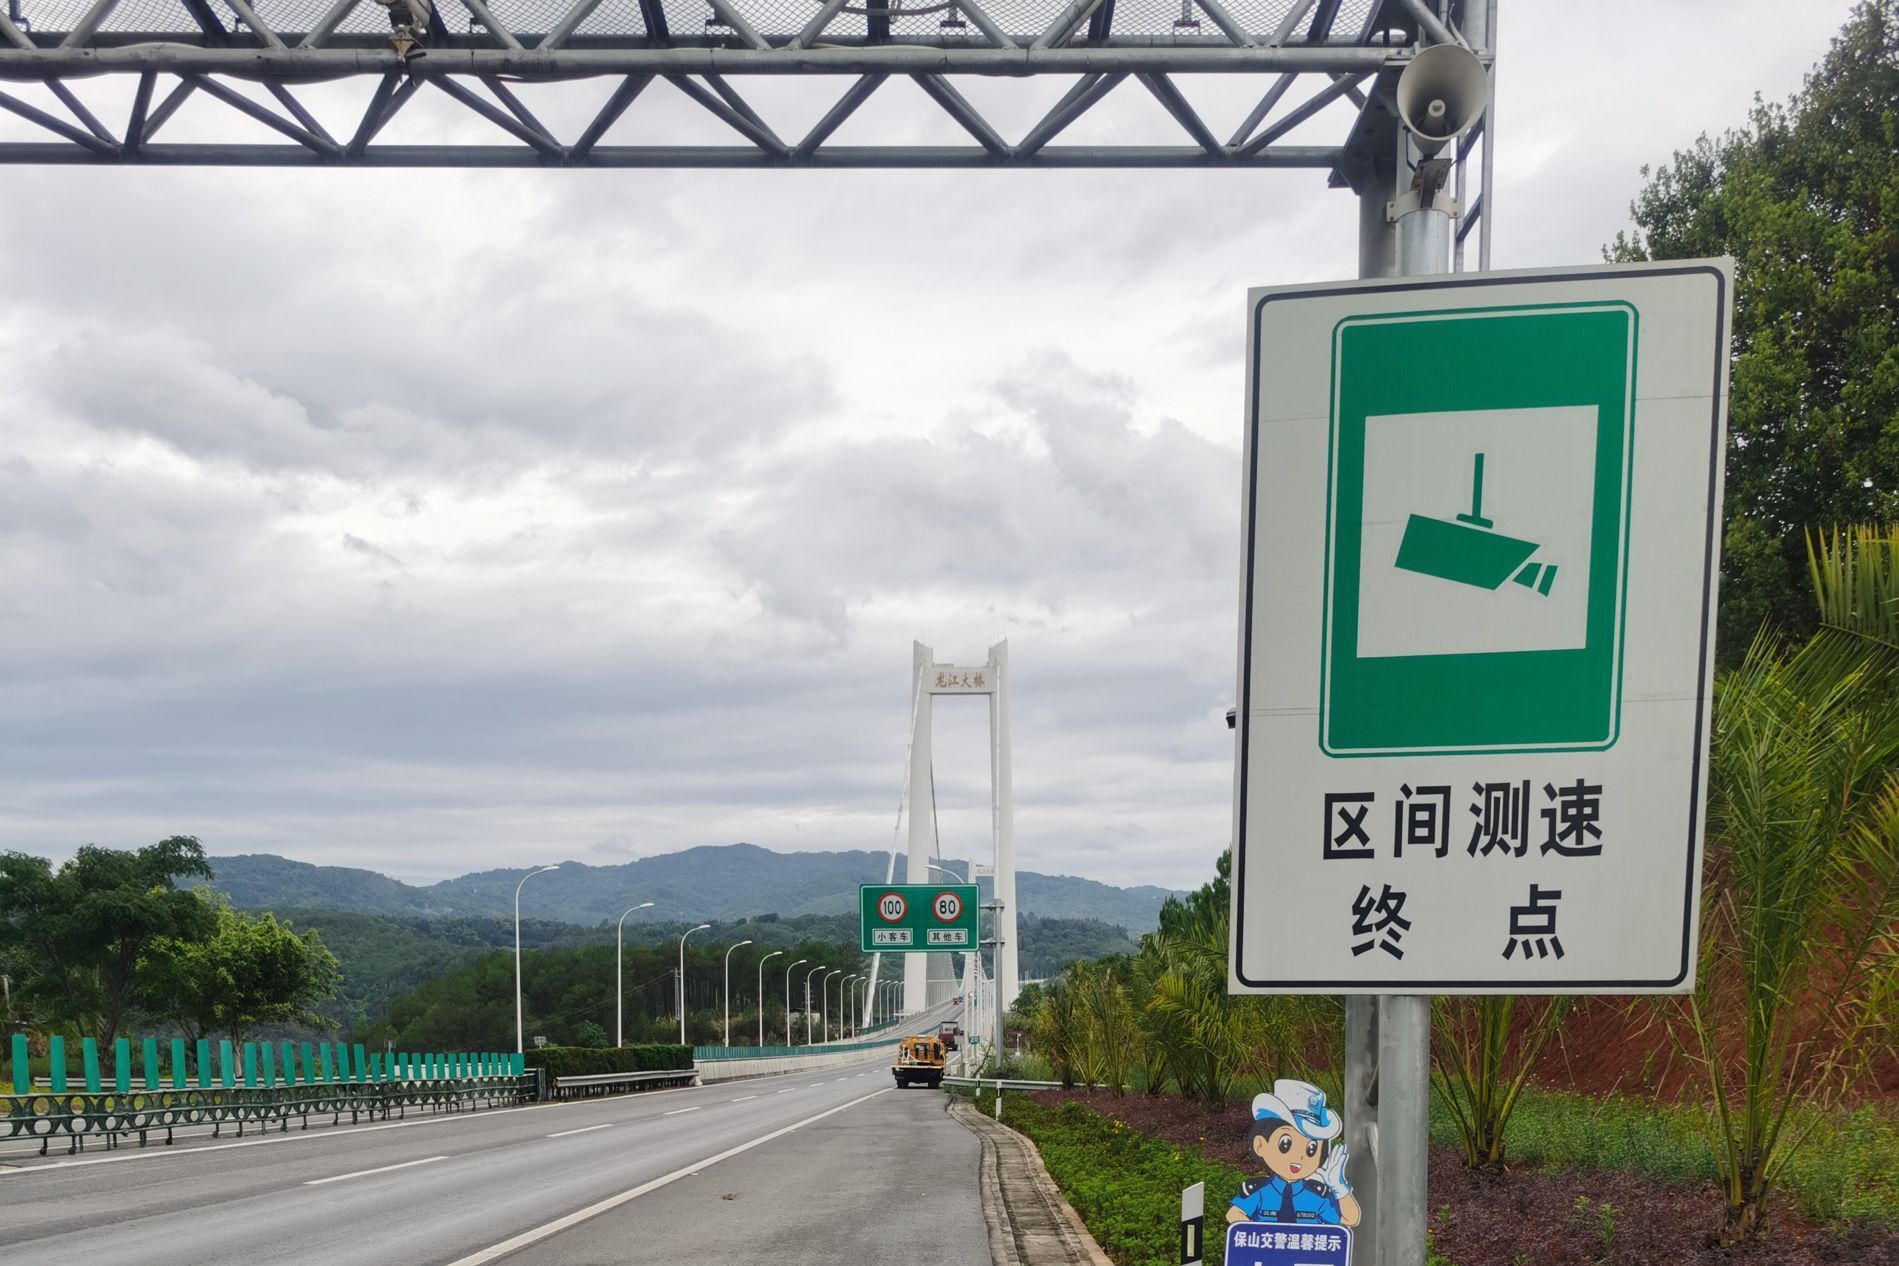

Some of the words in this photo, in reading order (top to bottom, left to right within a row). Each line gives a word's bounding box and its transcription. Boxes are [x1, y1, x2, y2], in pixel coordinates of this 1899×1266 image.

[1323, 779, 1603, 859] 区间测速
[883, 900, 902, 915] 100
[939, 900, 956, 914] 80
[877, 932, 909, 941] 小客车
[931, 932, 963, 941] 其他车
[1234, 1231, 1342, 1251] 保山交警温馨提示
